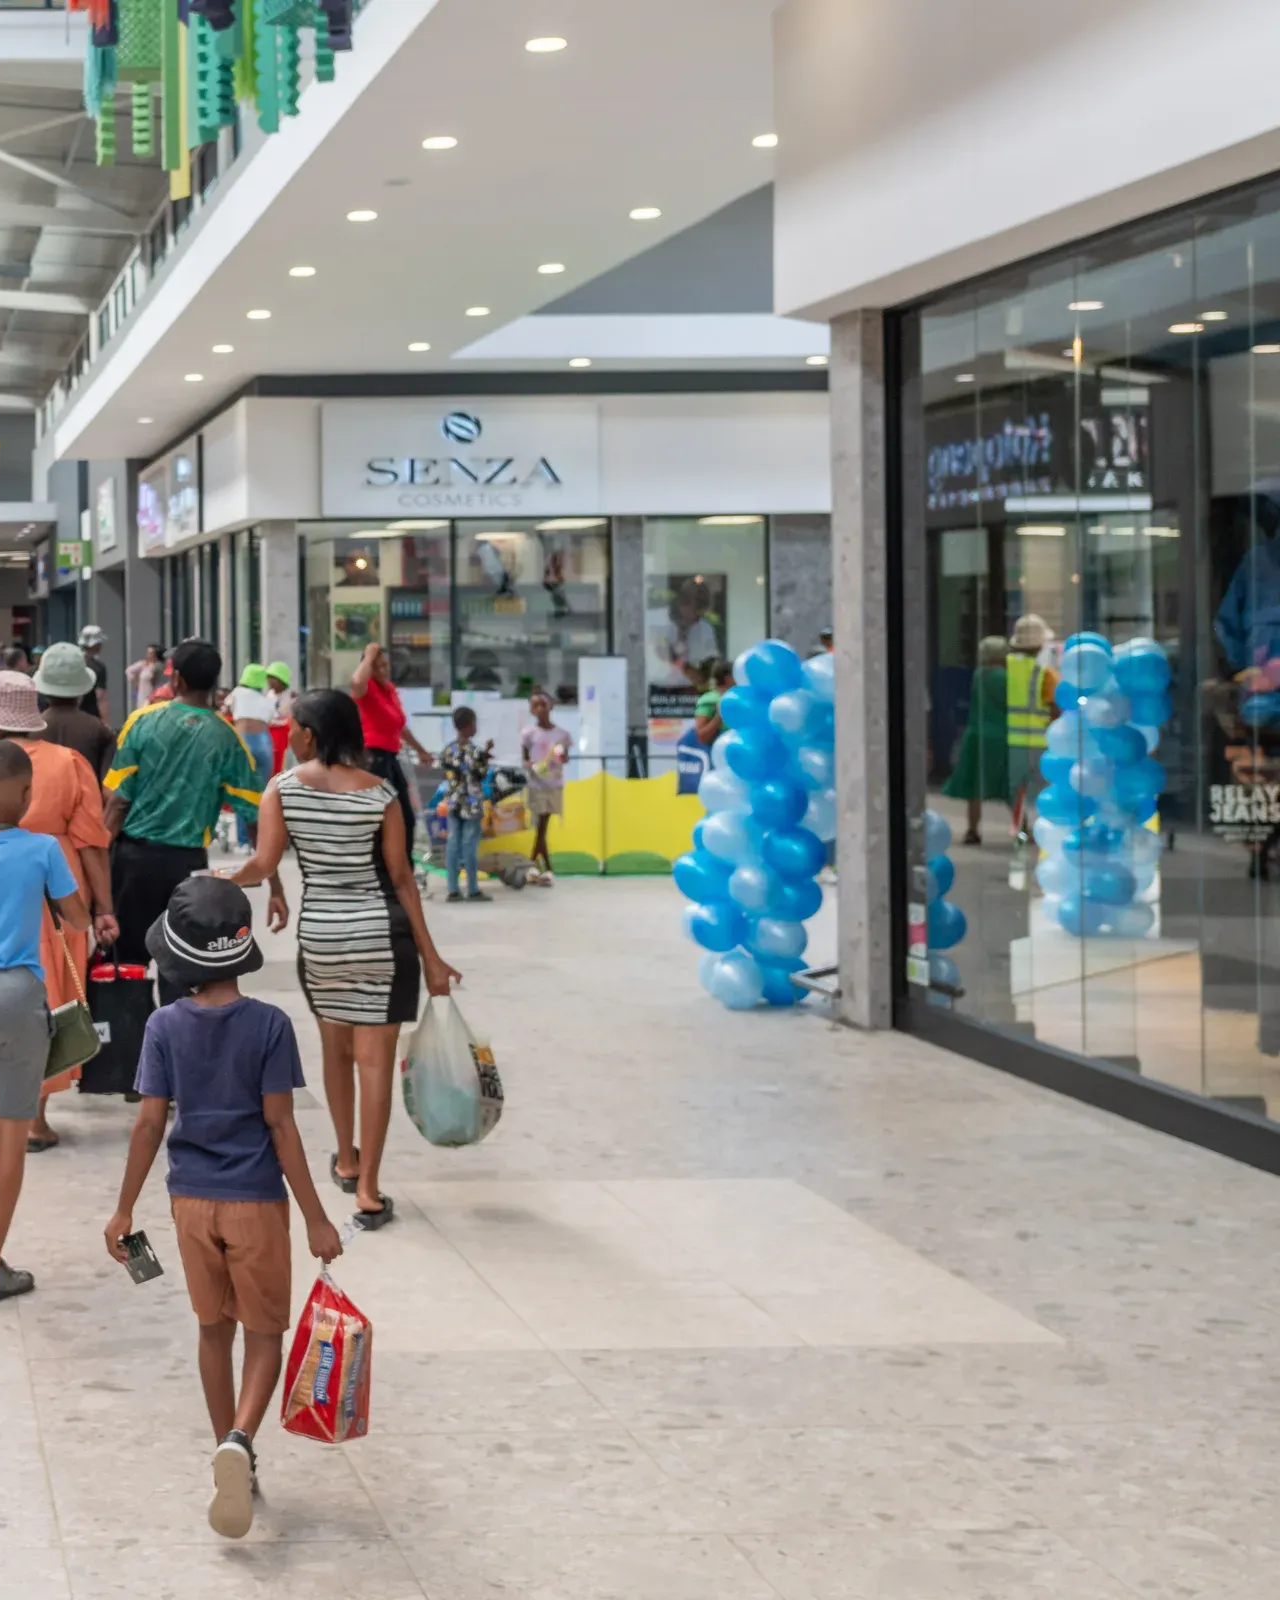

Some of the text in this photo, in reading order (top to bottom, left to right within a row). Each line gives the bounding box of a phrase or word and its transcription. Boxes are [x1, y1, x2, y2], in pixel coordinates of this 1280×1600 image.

[365, 457, 563, 486] SENZA
[398, 493, 522, 509] COSMETICS
[1210, 785, 1280, 803] RELAY
[314, 1345, 334, 1400] BLUE RIBBON
